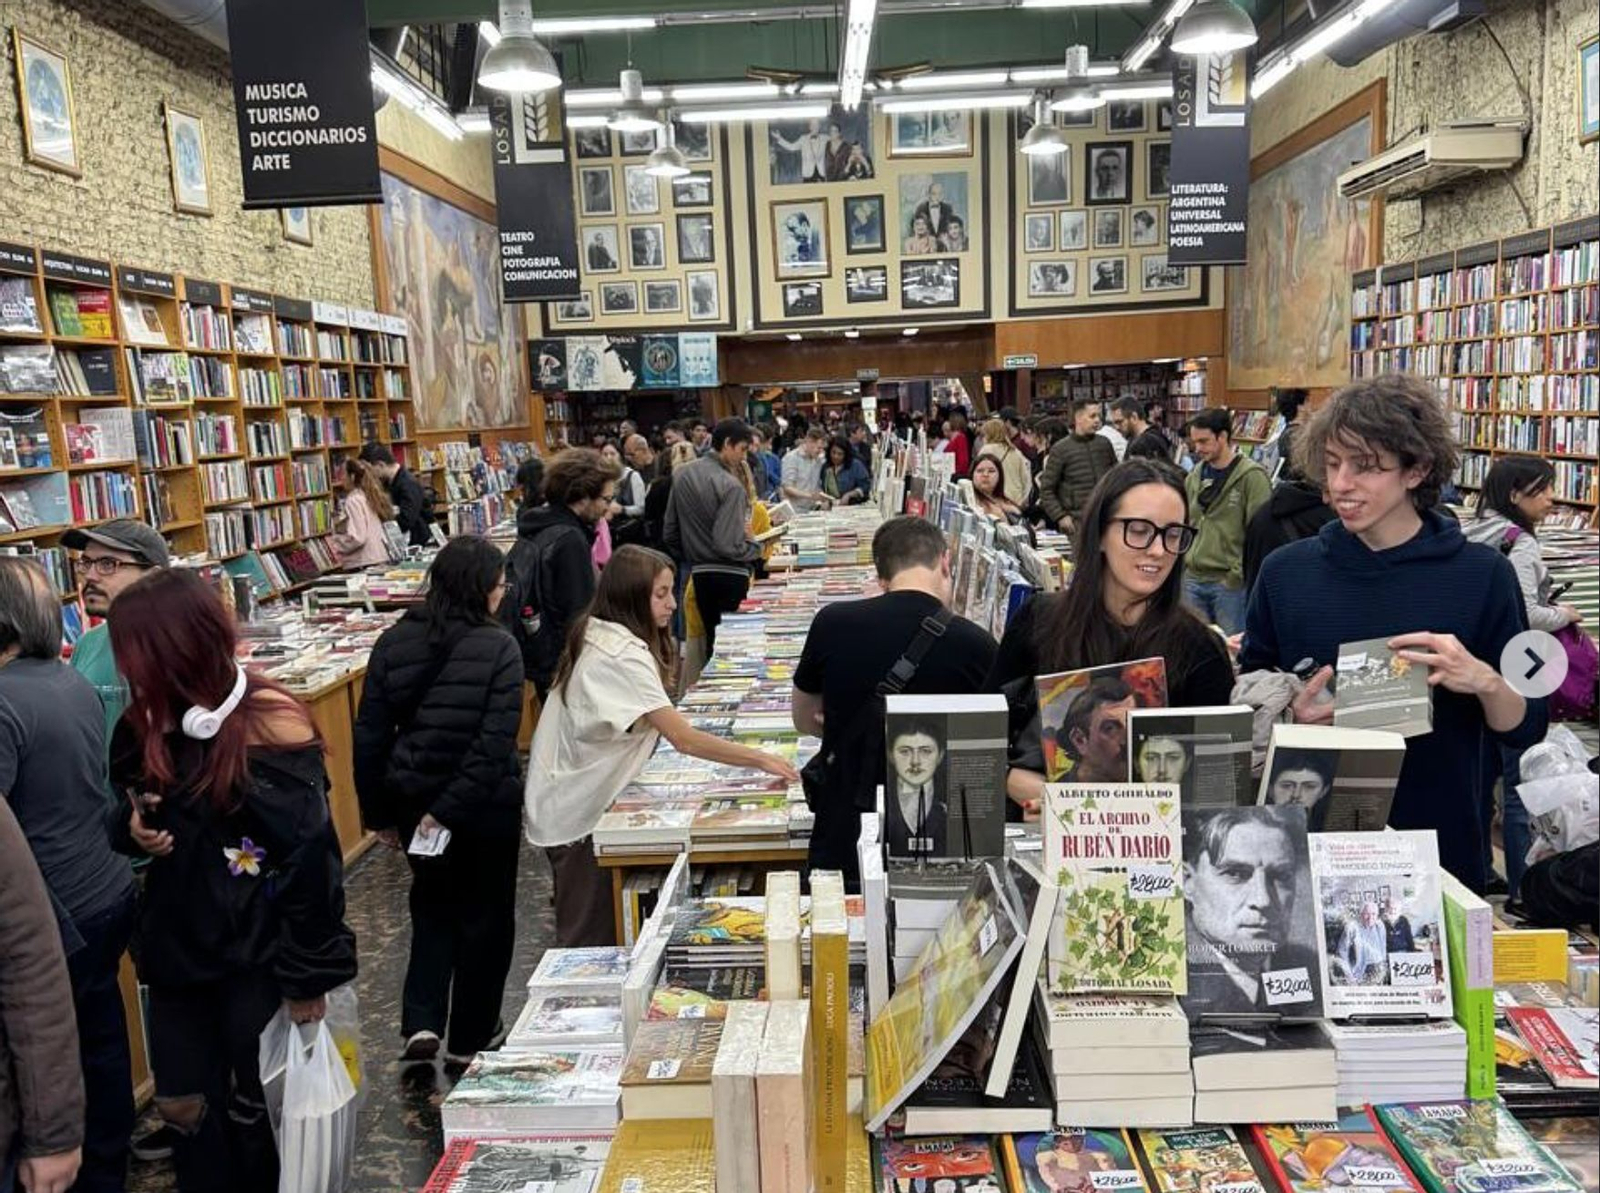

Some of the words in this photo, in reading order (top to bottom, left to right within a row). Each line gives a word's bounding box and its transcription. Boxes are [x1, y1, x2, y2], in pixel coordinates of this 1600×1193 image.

[245, 83, 308, 100] MUSICA
[1177, 57, 1191, 127] LOSAD
[247, 105, 320, 124] TURISMO
[250, 127, 367, 147] DICCIONARIOS
[252, 154, 291, 171] ARTE
[1171, 183, 1229, 194] LITERATURA:
[1171, 197, 1227, 208] ARGENTINA
[1170, 210, 1222, 221] UNIVERSAL
[1170, 222, 1245, 234] LATINOAMERICANA
[500, 232, 535, 243] TEATRO
[1170, 236, 1203, 248] POESIA
[502, 245, 524, 256] CINE
[503, 257, 561, 268] FOTOGRAFIA
[504, 269, 577, 281] COMUNICACION
[1057, 789, 1110, 799] ALBERTO
[1113, 789, 1173, 799] GHIRALDO
[1079, 812, 1095, 826] EL
[1099, 811, 1150, 826] ARCHIVO
[1108, 826, 1122, 834] DE
[1062, 832, 1115, 859] RUBÉN
[1120, 832, 1171, 859] DARÍO
[1130, 978, 1172, 989] LOSADA
